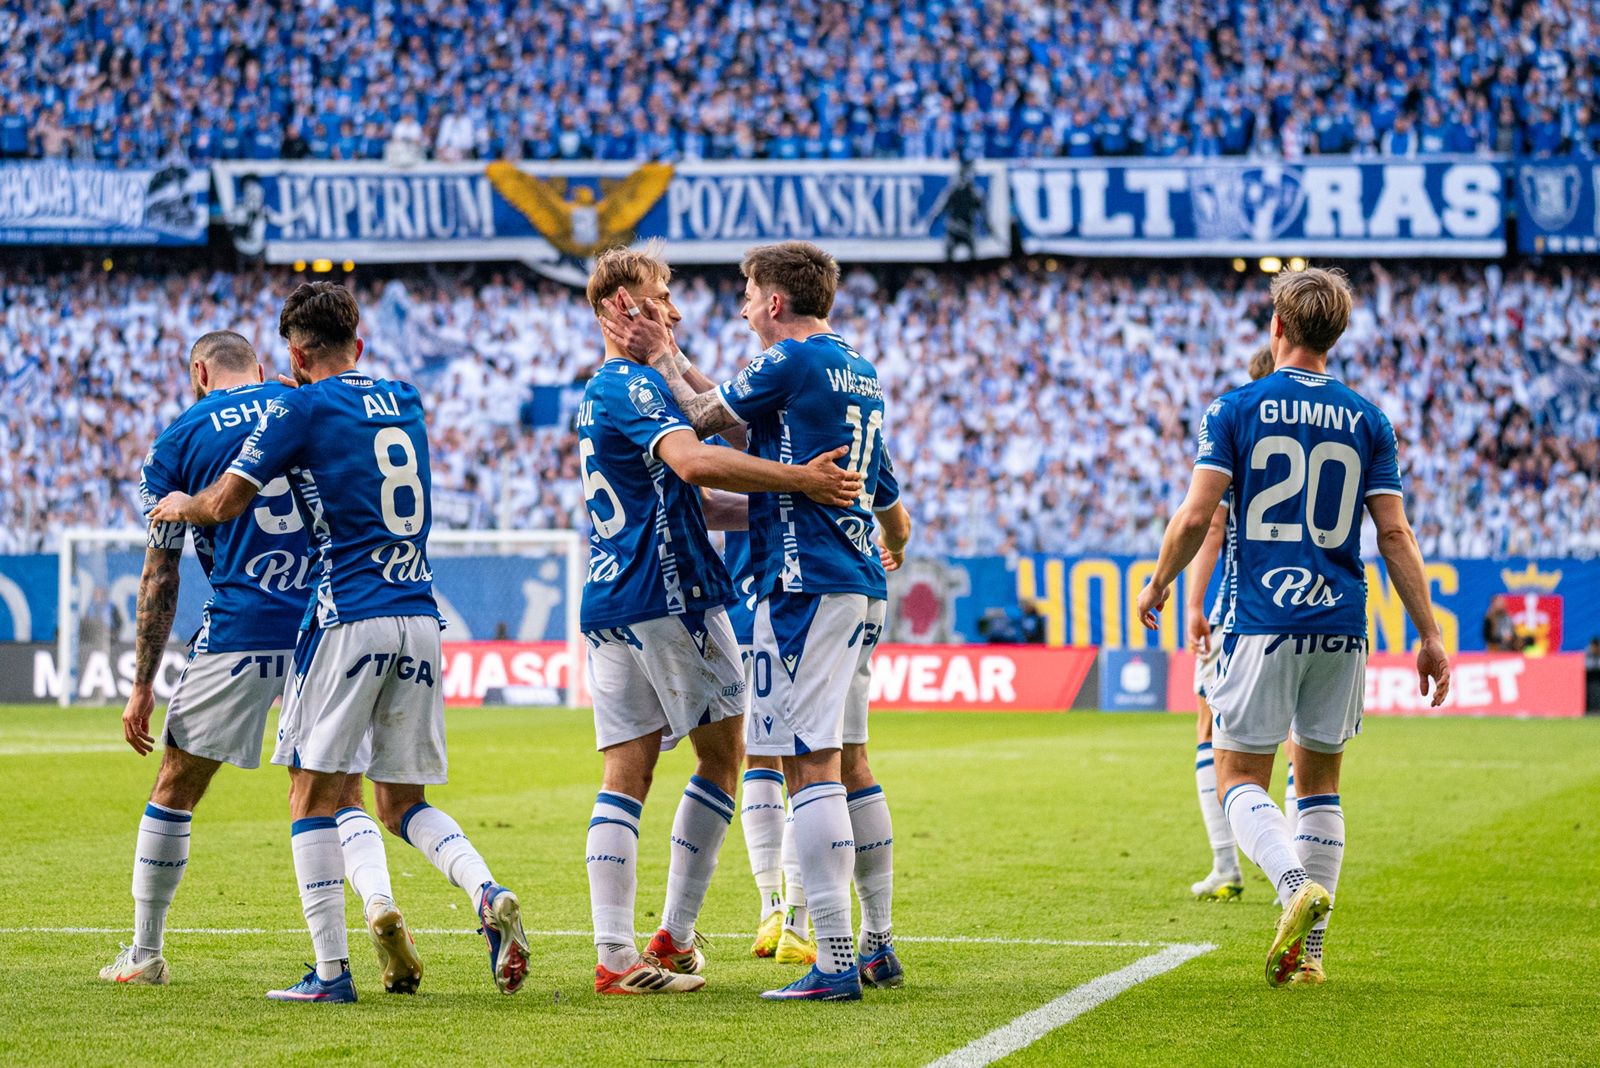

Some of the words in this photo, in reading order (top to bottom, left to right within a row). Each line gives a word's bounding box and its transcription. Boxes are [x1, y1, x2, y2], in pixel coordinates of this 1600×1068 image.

[278, 176, 494, 238] IMPERIUM
[210, 399, 274, 432] ISH
[362, 391, 400, 418] ALI
[1260, 399, 1363, 433] GUMNY
[374, 426, 425, 536] 8
[1246, 435, 1361, 549] 20
[245, 550, 310, 594] Pil
[371, 540, 433, 583] Pils
[1261, 566, 1343, 608] Pils
[1264, 634, 1363, 656] STIGA
[231, 655, 285, 679] STI
[346, 653, 434, 688] STIGA
[306, 879, 338, 891] FORZA
